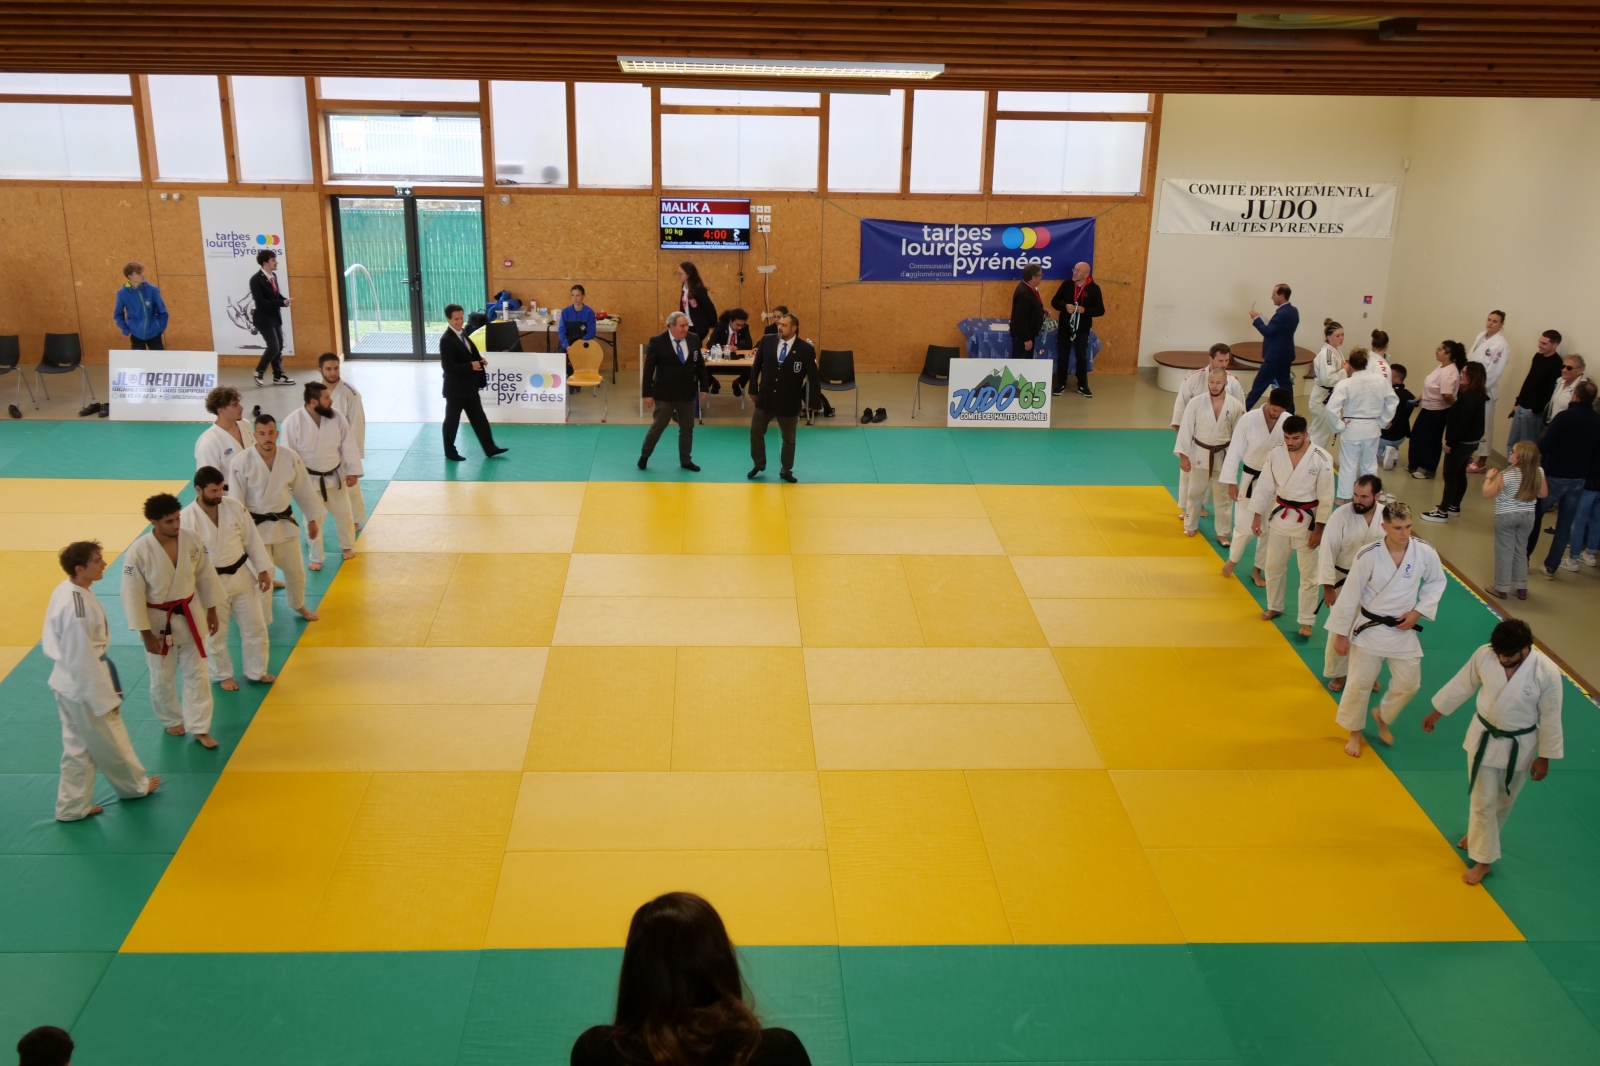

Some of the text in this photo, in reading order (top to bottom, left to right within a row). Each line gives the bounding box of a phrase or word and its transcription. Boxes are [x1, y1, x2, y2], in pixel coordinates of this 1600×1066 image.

[1188, 182, 1375, 198] COMITE DEPARTEMENTAL
[662, 202, 711, 212] MALIK A
[1240, 199, 1318, 221] JUDO
[662, 216, 713, 226] LOYER N
[1210, 220, 1344, 235] HAUTES PYRENEES
[215, 231, 251, 241] tarbes
[674, 228, 683, 236] kg
[703, 230, 727, 239] 4:00
[922, 224, 992, 241] tarbes
[206, 239, 247, 248] lourdes
[901, 238, 983, 256] lourdes
[953, 251, 1052, 277] pyrénées
[112, 372, 215, 387] JL CREATIONS
[485, 369, 522, 382] arbes
[498, 390, 564, 406] pyrénées
[950, 381, 1047, 419] JUDO 65
[982, 412, 994, 421] DES
